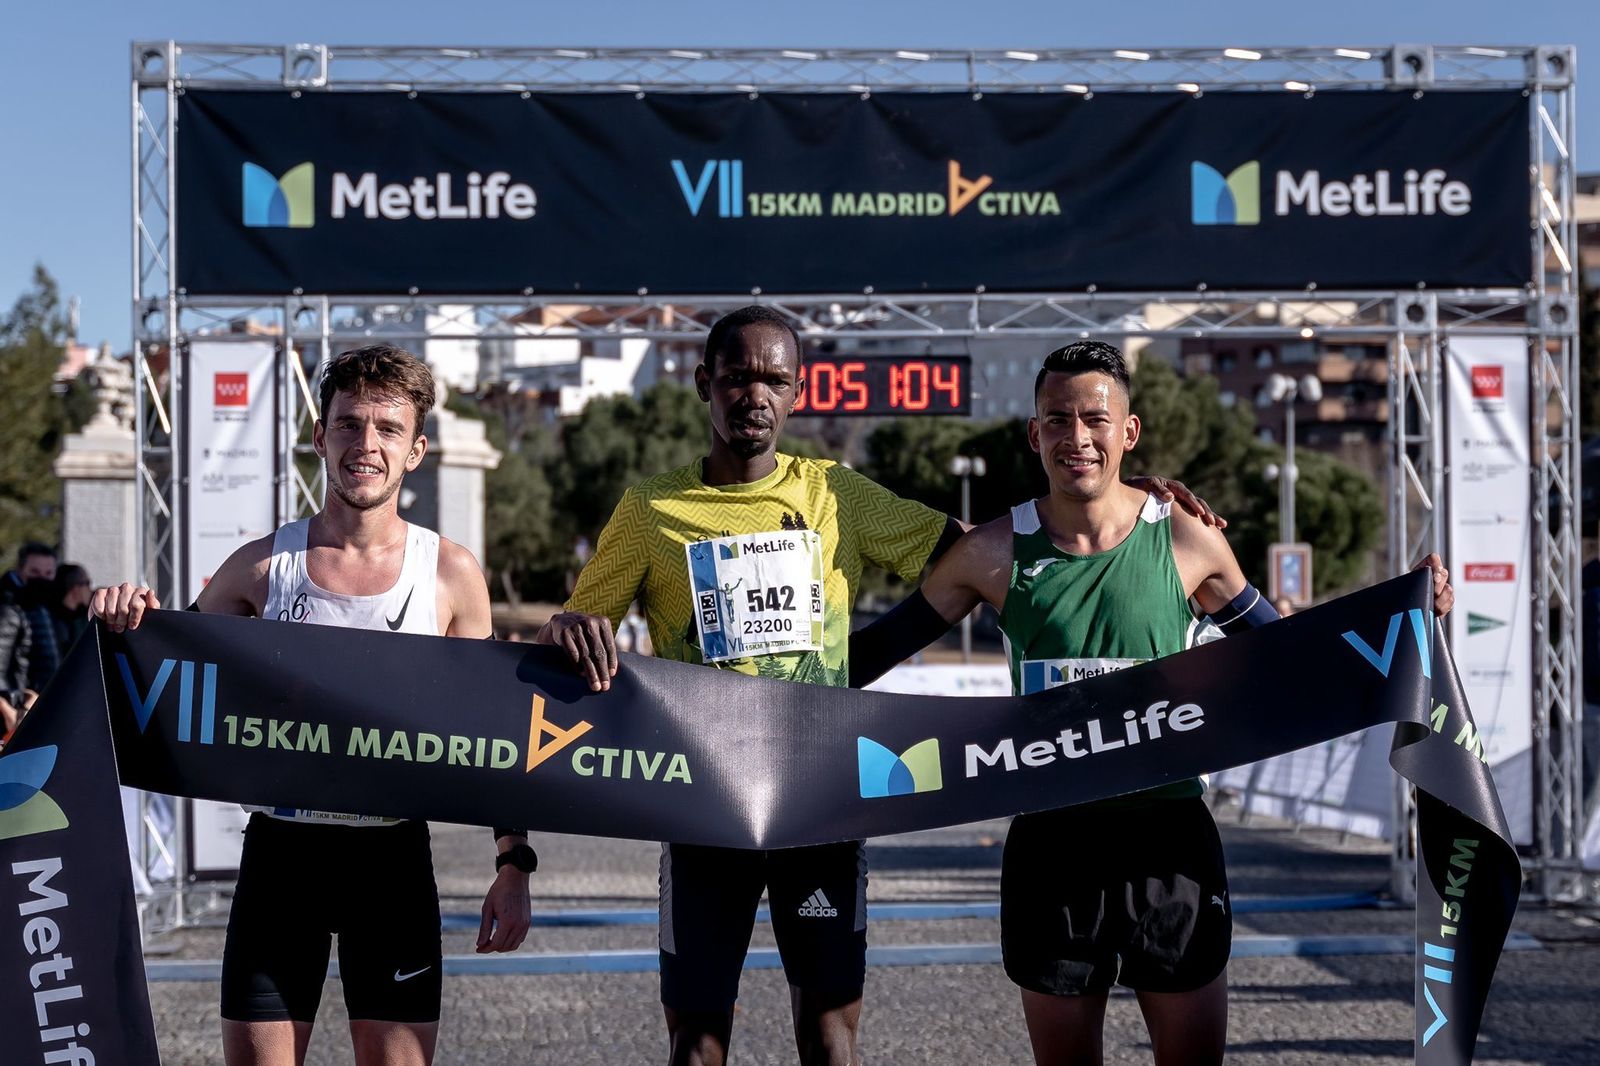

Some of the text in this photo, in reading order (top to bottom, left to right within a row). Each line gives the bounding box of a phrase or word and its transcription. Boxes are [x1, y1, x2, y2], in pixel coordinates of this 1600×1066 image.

[331, 171, 537, 220] MetLife
[671, 159, 743, 218] VII
[748, 192, 823, 217] 15KM
[831, 192, 946, 217] MADRID
[1275, 168, 1472, 217] MetLife
[743, 540, 796, 555] MetLife
[746, 585, 797, 613] 542
[743, 618, 793, 635] 23200
[114, 652, 218, 745] VII
[223, 714, 331, 754] 15KM
[346, 726, 519, 770] MADRID
[965, 700, 1205, 778] MetLife
[332, 813, 358, 822] MADRID
[798, 906, 838, 917] adidas
[1422, 837, 1480, 1047] VII 15KM
